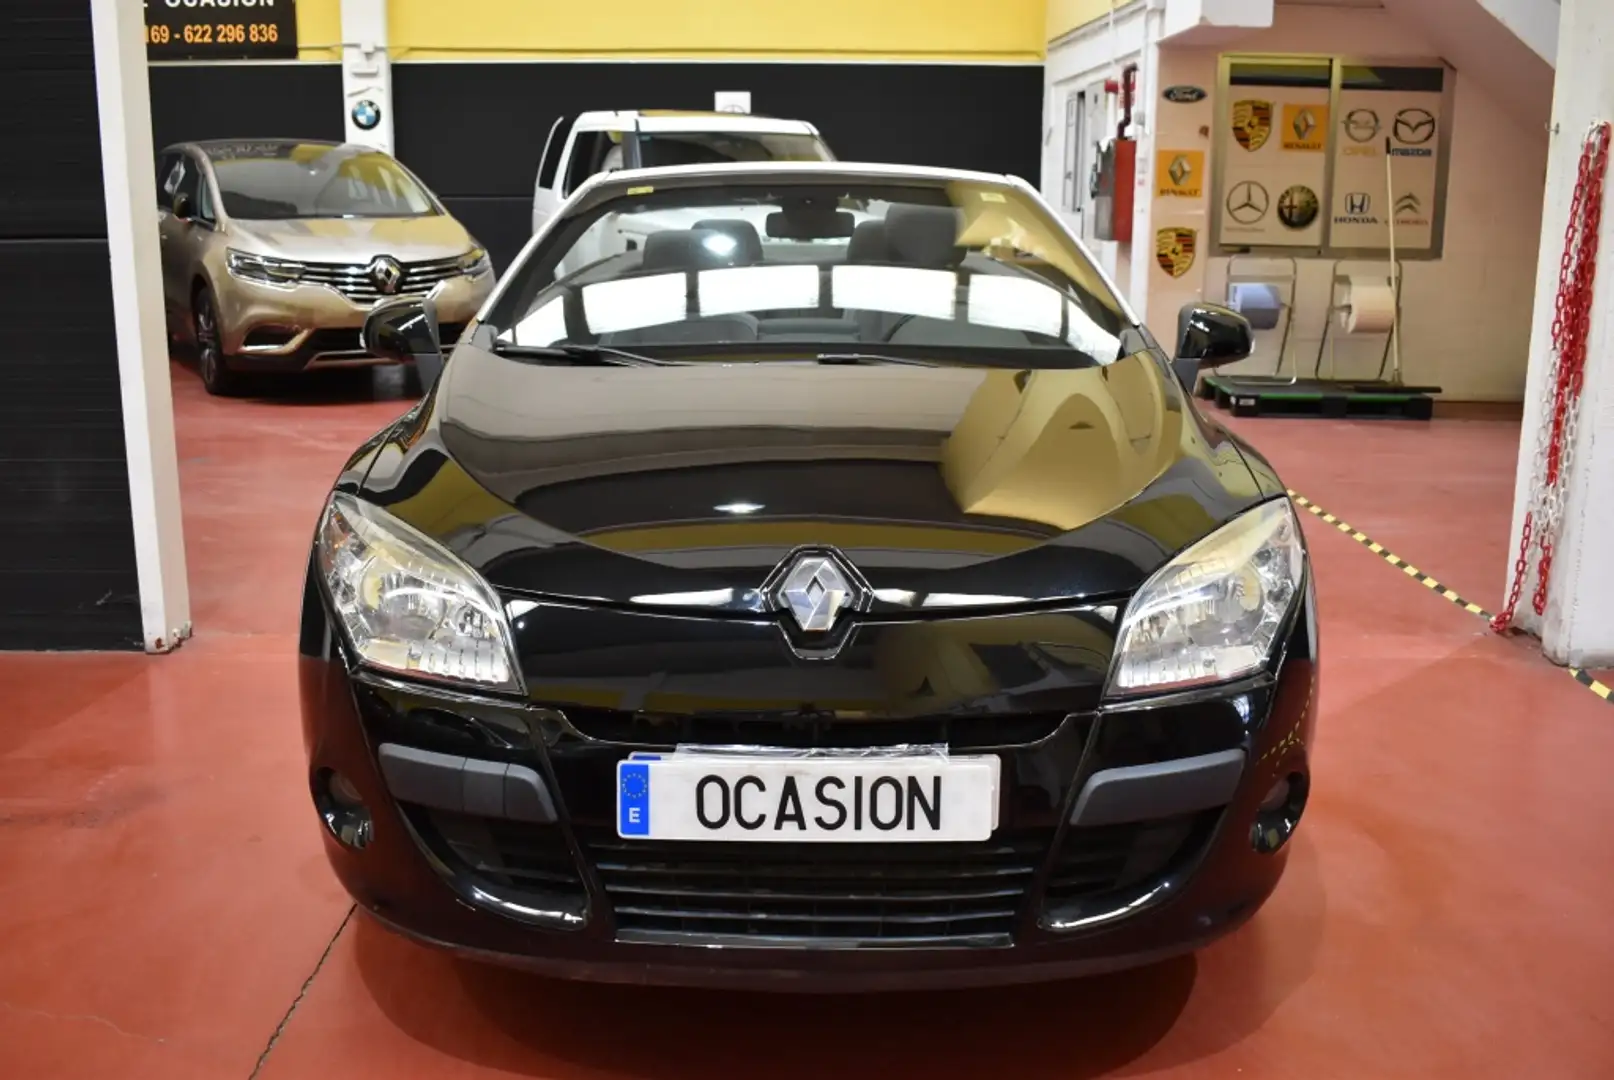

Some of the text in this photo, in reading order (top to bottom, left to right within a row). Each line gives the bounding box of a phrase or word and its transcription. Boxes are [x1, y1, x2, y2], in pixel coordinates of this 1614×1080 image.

[184, 24, 213, 44] 622
[216, 24, 245, 43] 296
[248, 23, 278, 43] 836
[1334, 215, 1379, 225] HONDA
[695, 774, 942, 831] OCASION
[628, 807, 641, 823] E
